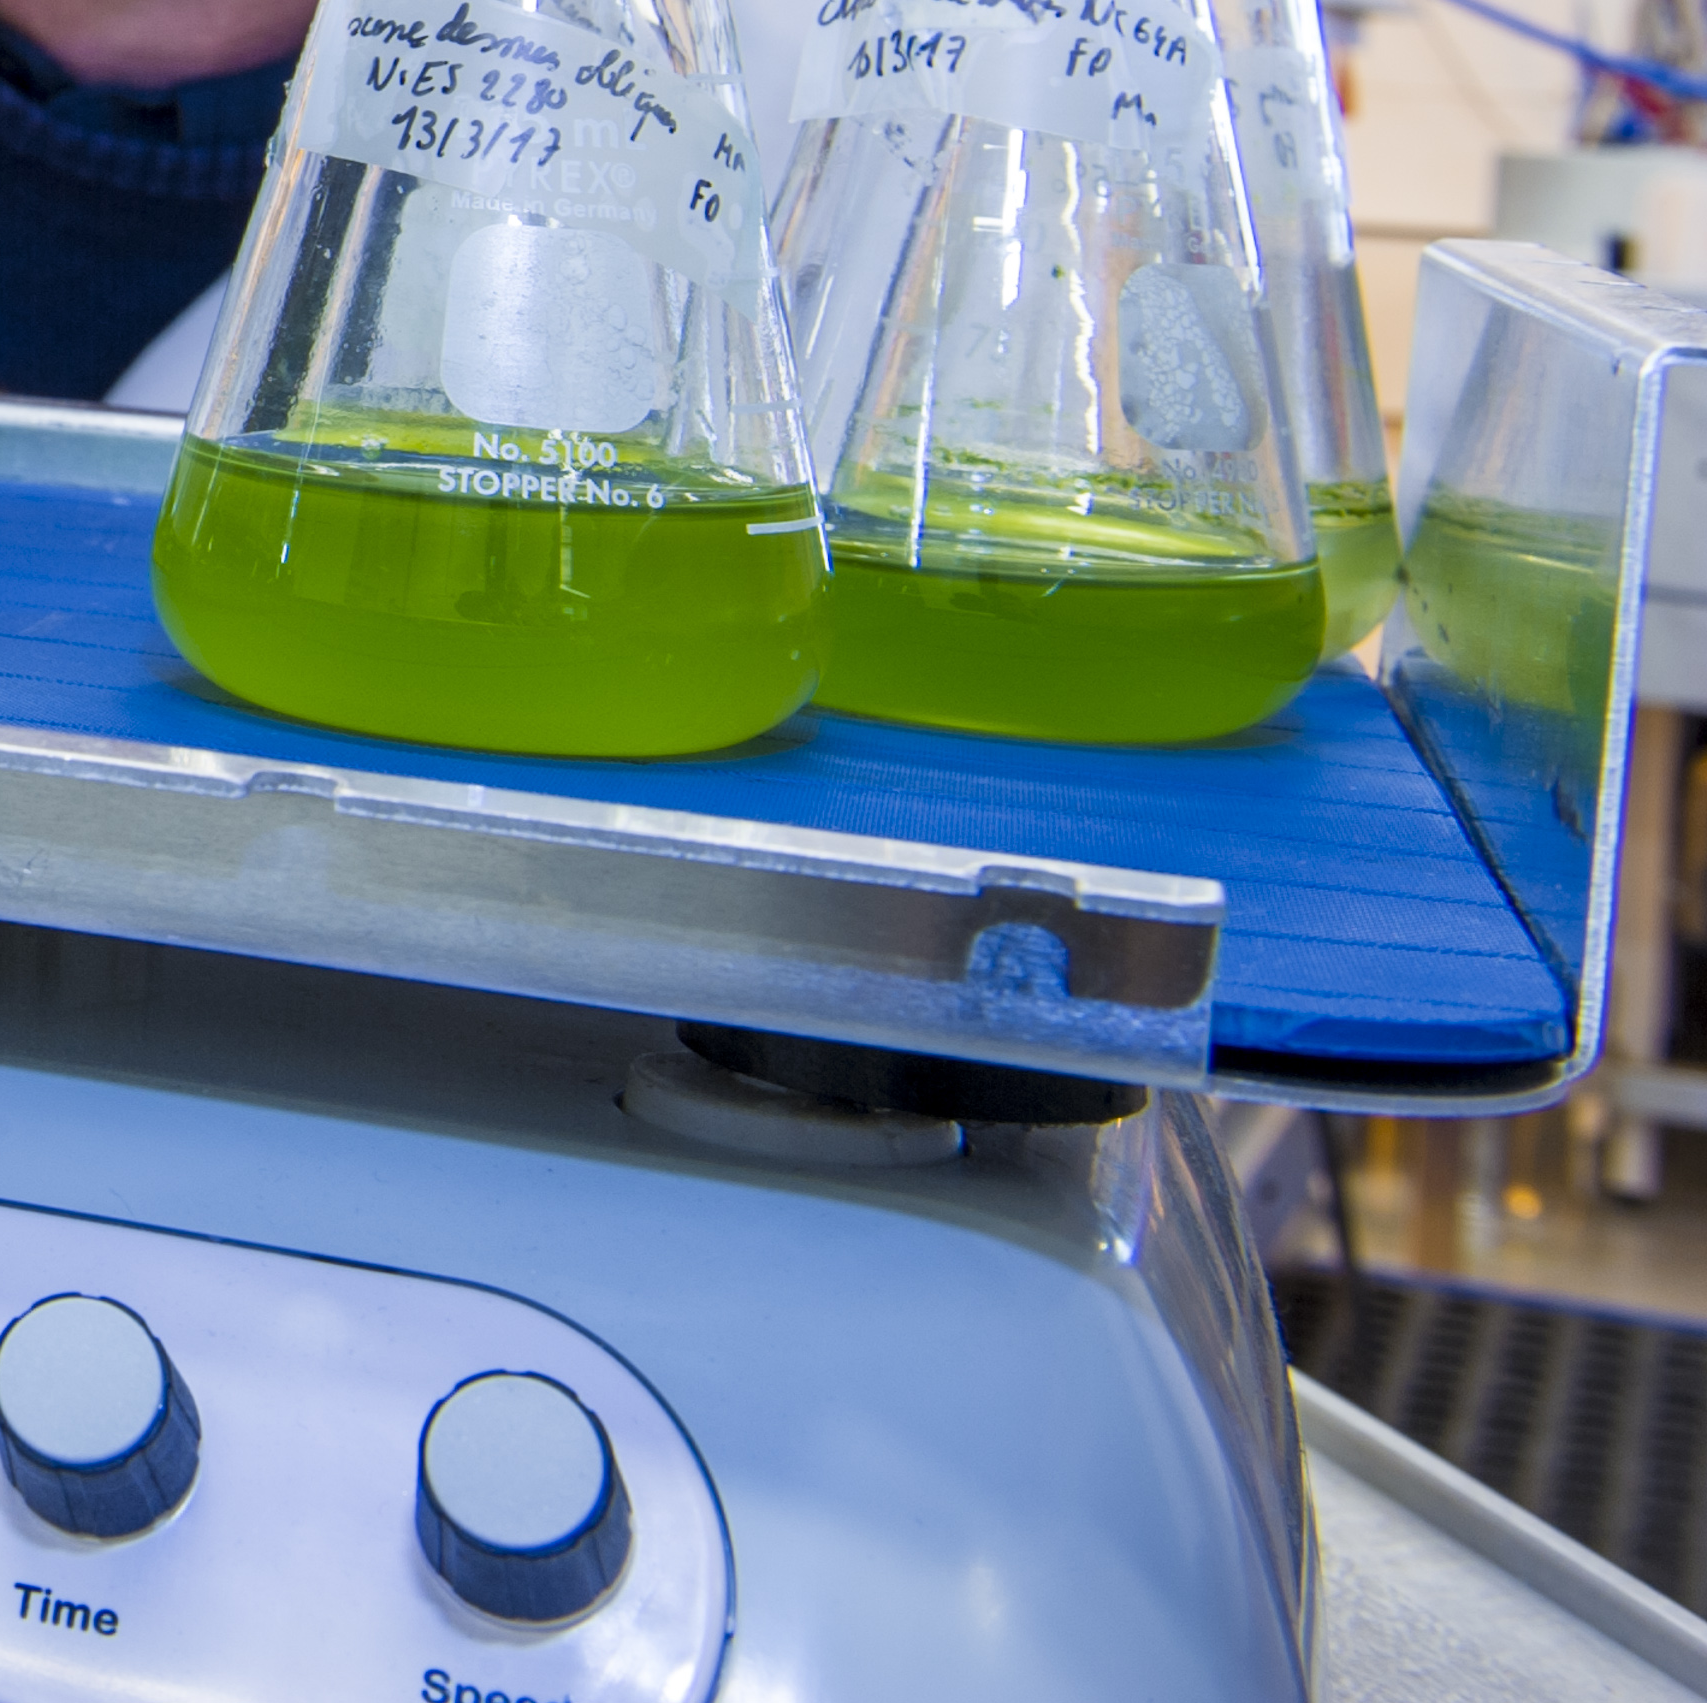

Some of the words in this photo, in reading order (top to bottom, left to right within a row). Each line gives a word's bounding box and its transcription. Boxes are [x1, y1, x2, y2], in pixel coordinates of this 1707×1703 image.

[392, 105, 562, 167] 13/3/17
[473, 431, 530, 463] No.
[538, 438, 617, 469] 5100
[438, 467, 577, 503] STOPPER
[586, 478, 639, 508] No.
[647, 483, 666, 509] 6
[14, 1582, 119, 1636] Time
